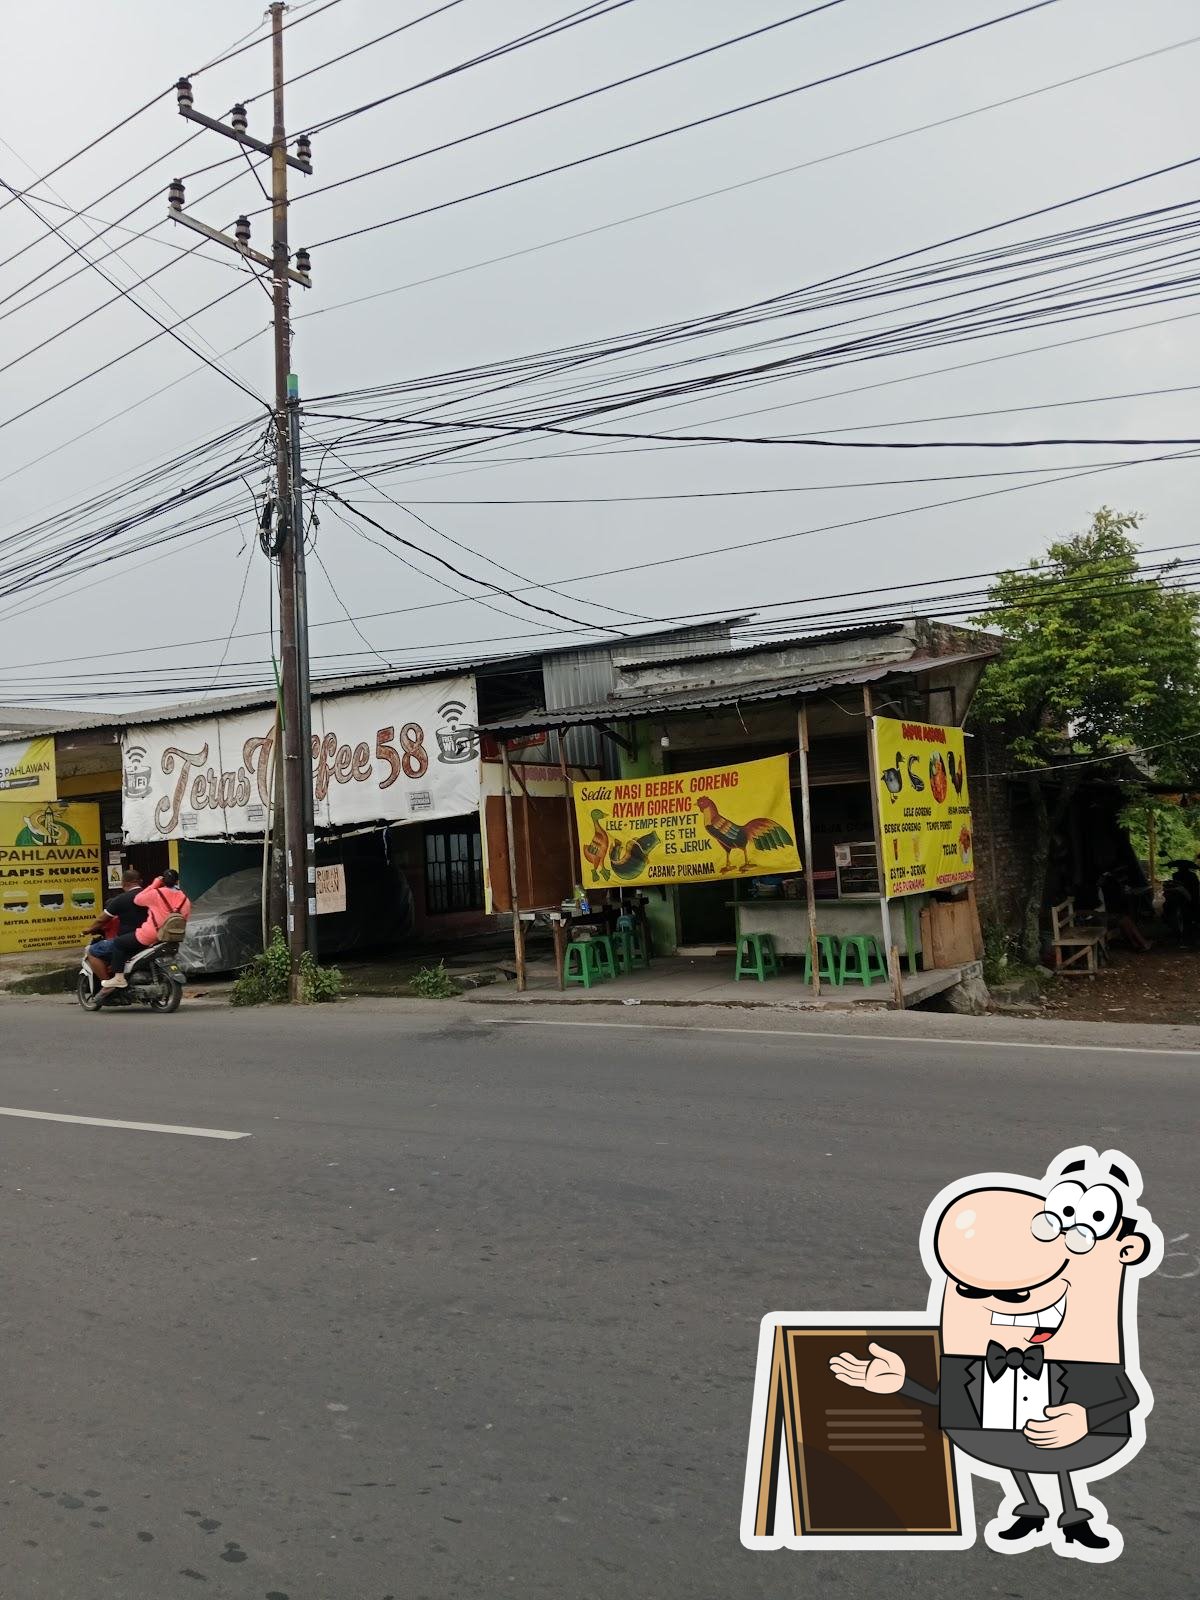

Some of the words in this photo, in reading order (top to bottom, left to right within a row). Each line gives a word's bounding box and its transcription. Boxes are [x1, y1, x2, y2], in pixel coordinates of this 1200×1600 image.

[5, 761, 50, 777] PAHLAWAN
[154, 742, 251, 834] Teras
[376, 722, 429, 790] 58
[581, 786, 612, 801] Sedia
[614, 784, 642, 800] NASI
[645, 780, 684, 798] BEBEK
[690, 771, 739, 793] GORENG
[612, 801, 645, 818] AYAM
[647, 796, 692, 816] GORENG
[904, 807, 914, 817] LELE
[915, 807, 932, 817] GORENG
[606, 820, 623, 831] LELE
[629, 818, 658, 830] TEMPE
[660, 814, 699, 828] PENYET
[884, 823, 900, 834] BEBEK
[901, 822, 921, 833] GORENG
[665, 829, 676, 841] ES
[678, 828, 696, 839] TEH
[665, 843, 678, 854] ES
[680, 839, 712, 854] JERUK
[942, 844, 957, 856] TELOR
[0, 848, 99, 861] PAHLAWAN
[0, 868, 44, 878] LAPIS
[49, 866, 100, 876] KUKUS
[648, 865, 676, 878] CABANG
[677, 862, 715, 877] PURNAMA
[910, 864, 927, 876] JERUK
